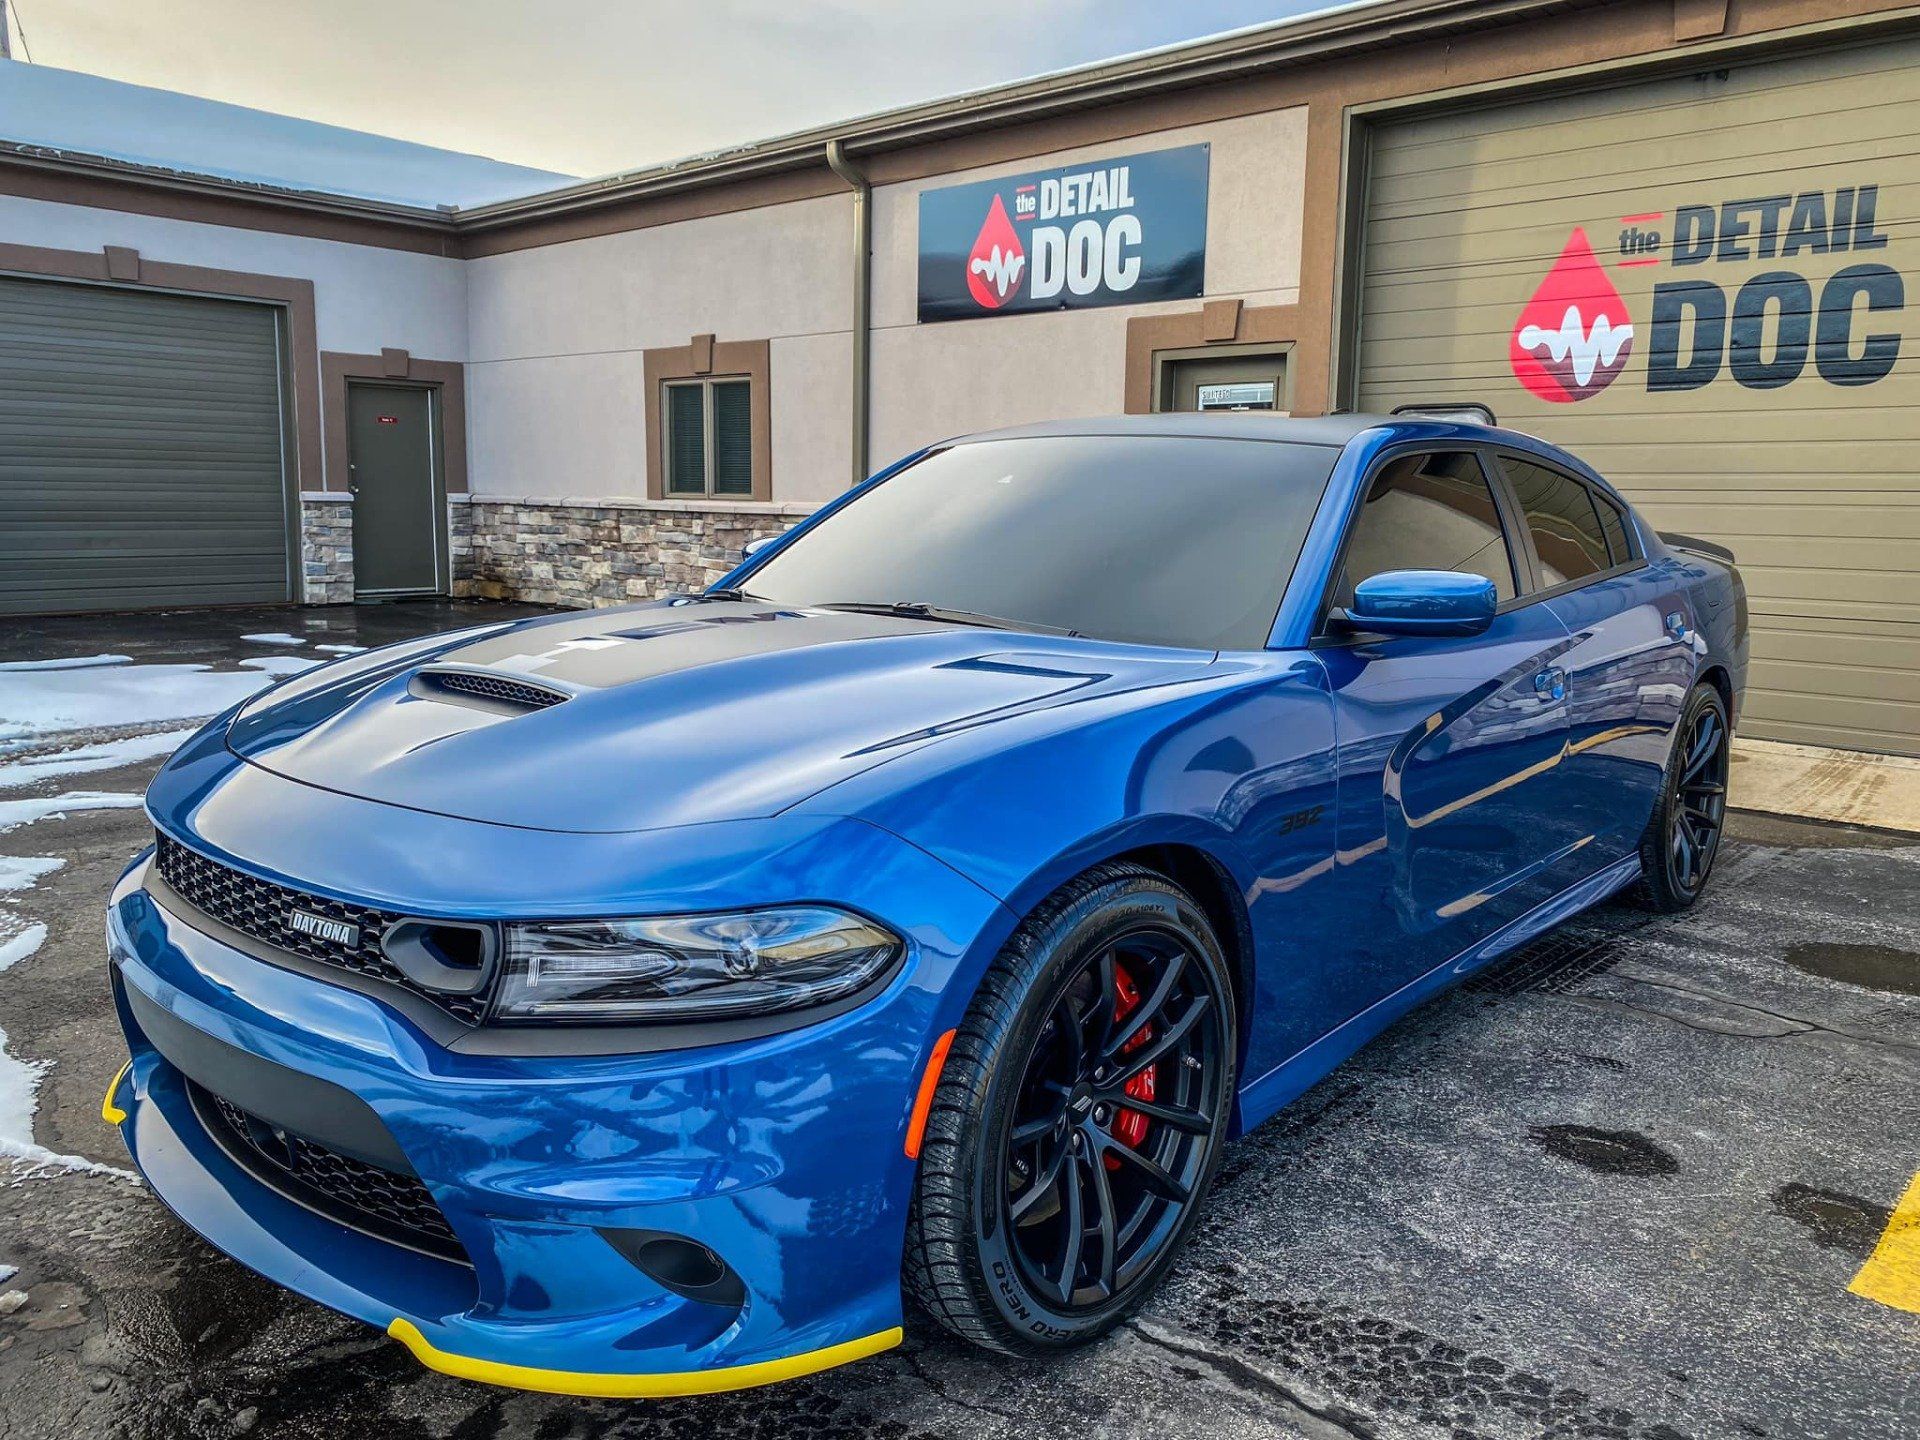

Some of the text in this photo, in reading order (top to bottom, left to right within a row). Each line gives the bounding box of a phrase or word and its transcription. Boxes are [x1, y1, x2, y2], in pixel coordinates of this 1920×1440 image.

[1015, 166, 1134, 220] the DETAIL
[1618, 184, 1888, 267] the DETAIL
[1030, 214, 1142, 299] DOC
[1646, 262, 1905, 393] DOC
[1276, 805, 1325, 836] 392
[292, 913, 351, 944] DAYTONA
[991, 1260, 1031, 1321] NERO
